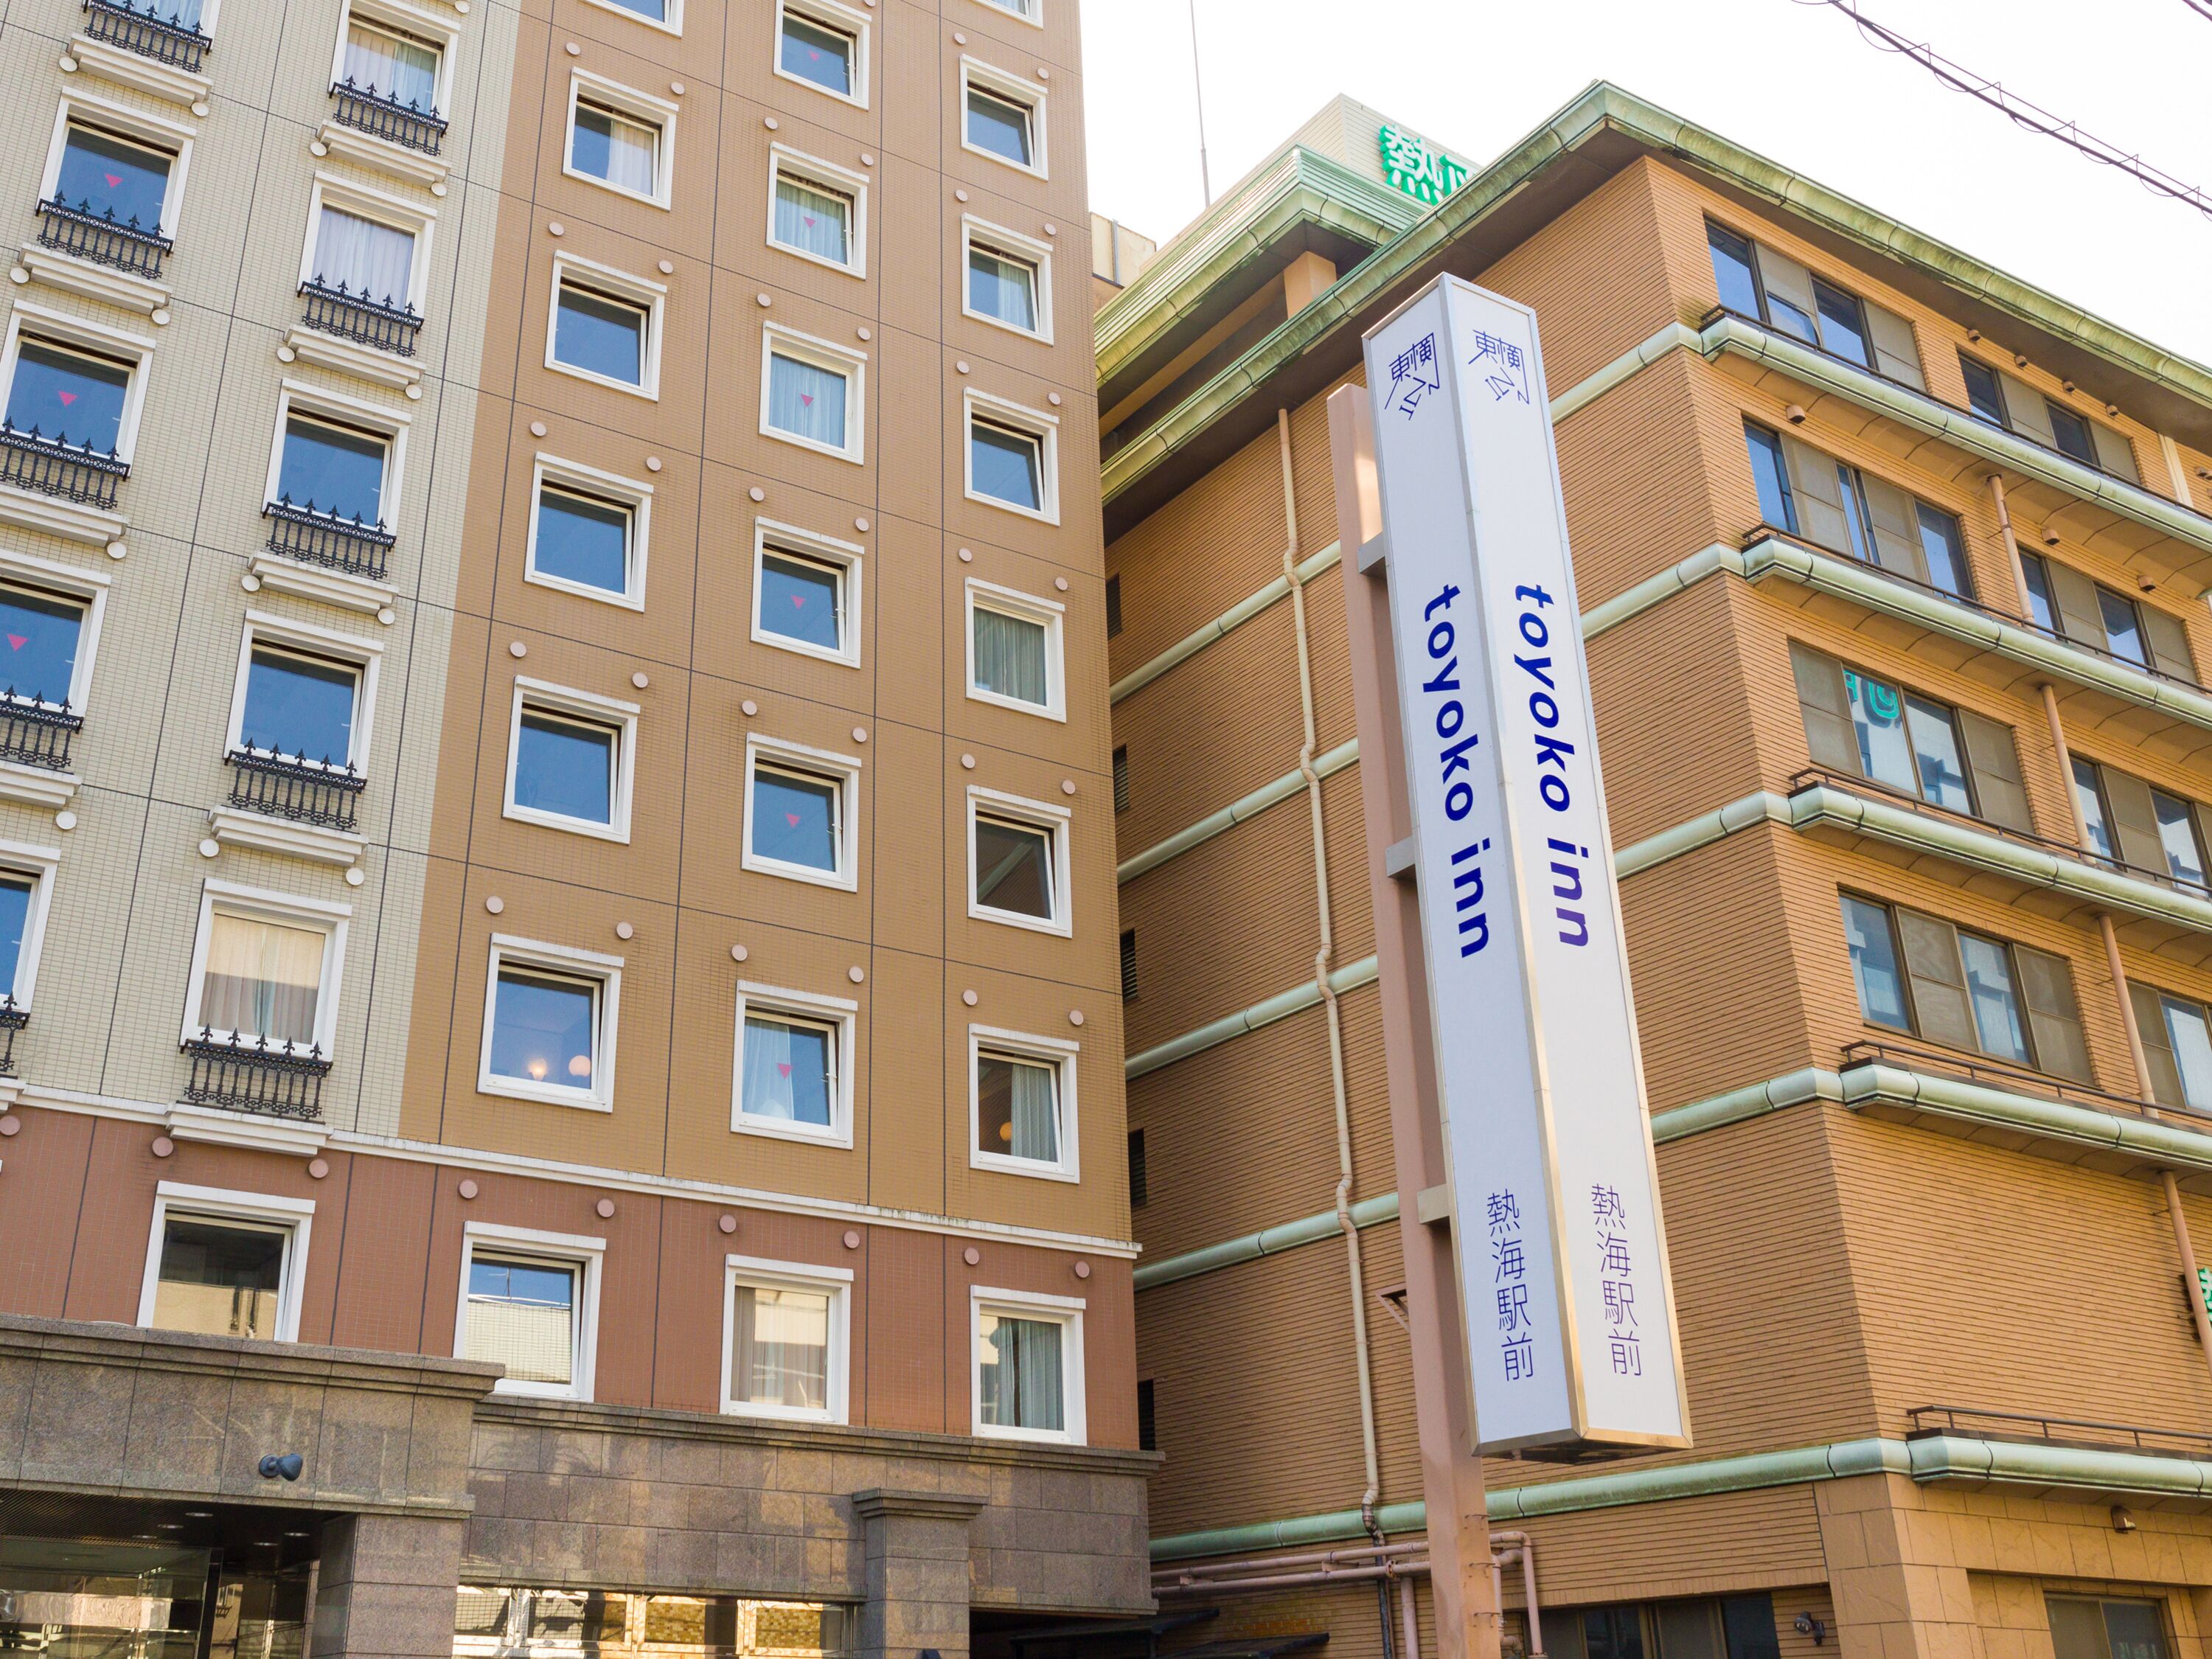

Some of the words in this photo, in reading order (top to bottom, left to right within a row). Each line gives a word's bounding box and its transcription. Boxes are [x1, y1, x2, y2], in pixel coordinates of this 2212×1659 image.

[1422, 584, 1479, 821] toyoko
[1451, 837, 1491, 958] inn
[1514, 584, 1576, 813] toyoko
[1547, 837, 1590, 947] inn
[1486, 1189, 1534, 1382] 熱海駅前
[1590, 1183, 1642, 1377] 熱海駅前
